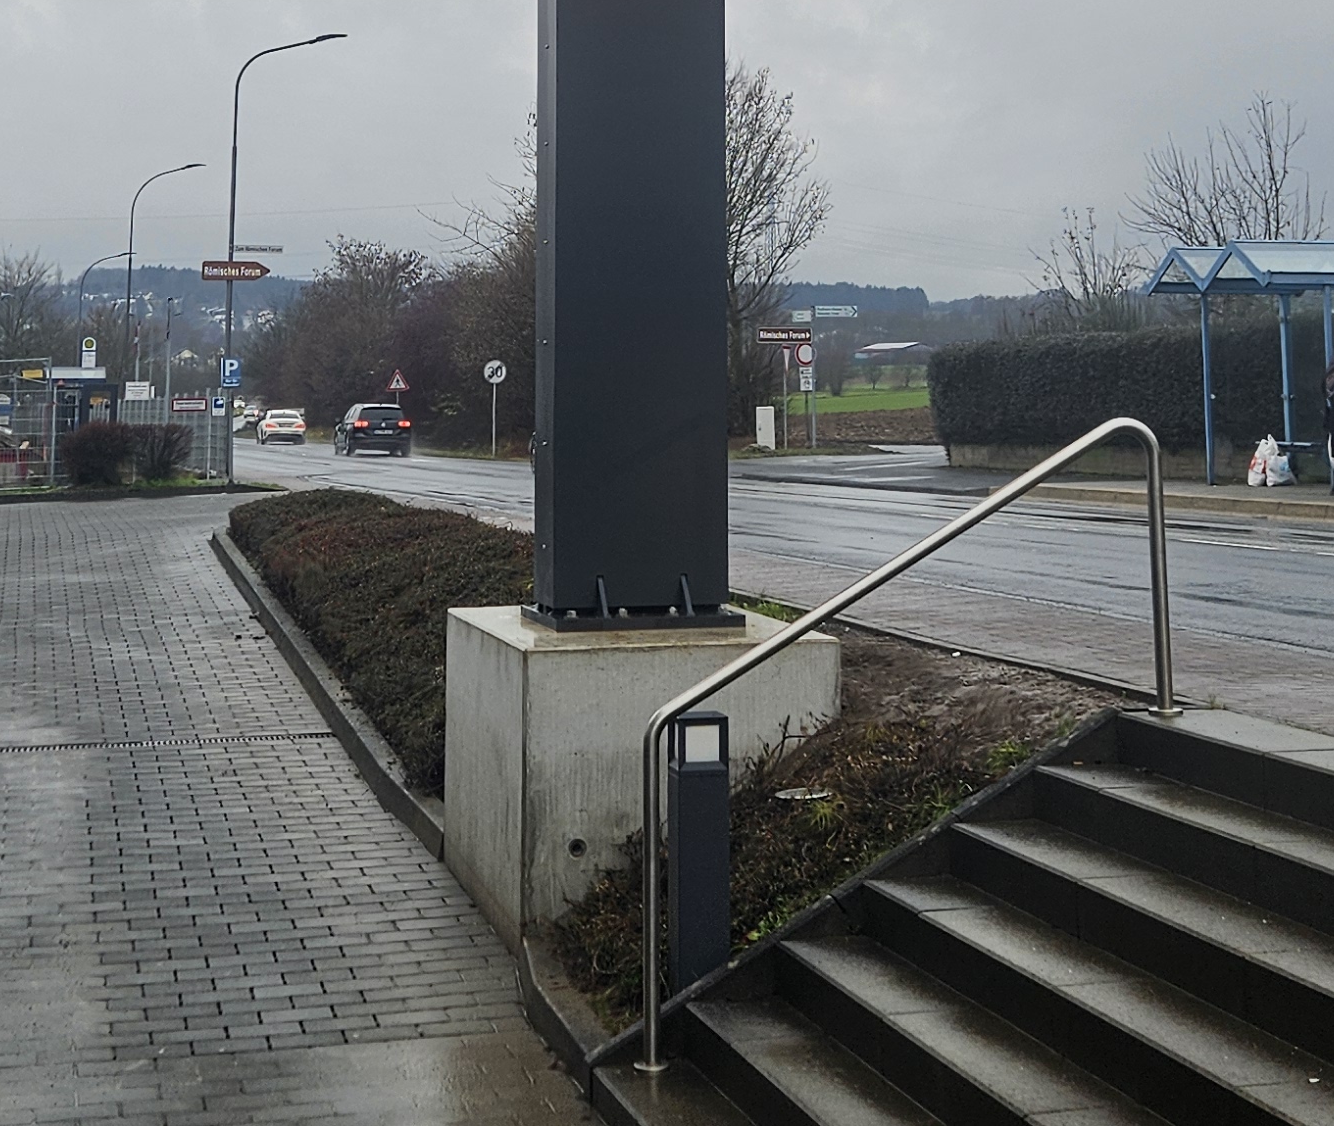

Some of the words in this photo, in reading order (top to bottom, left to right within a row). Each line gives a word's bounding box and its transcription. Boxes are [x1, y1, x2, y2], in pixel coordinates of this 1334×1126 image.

[204, 266, 239, 277] Römisches
[240, 266, 261, 277] Forum
[789, 330, 806, 340] Forum
[224, 359, 239, 376] P
[487, 365, 503, 379] 30
